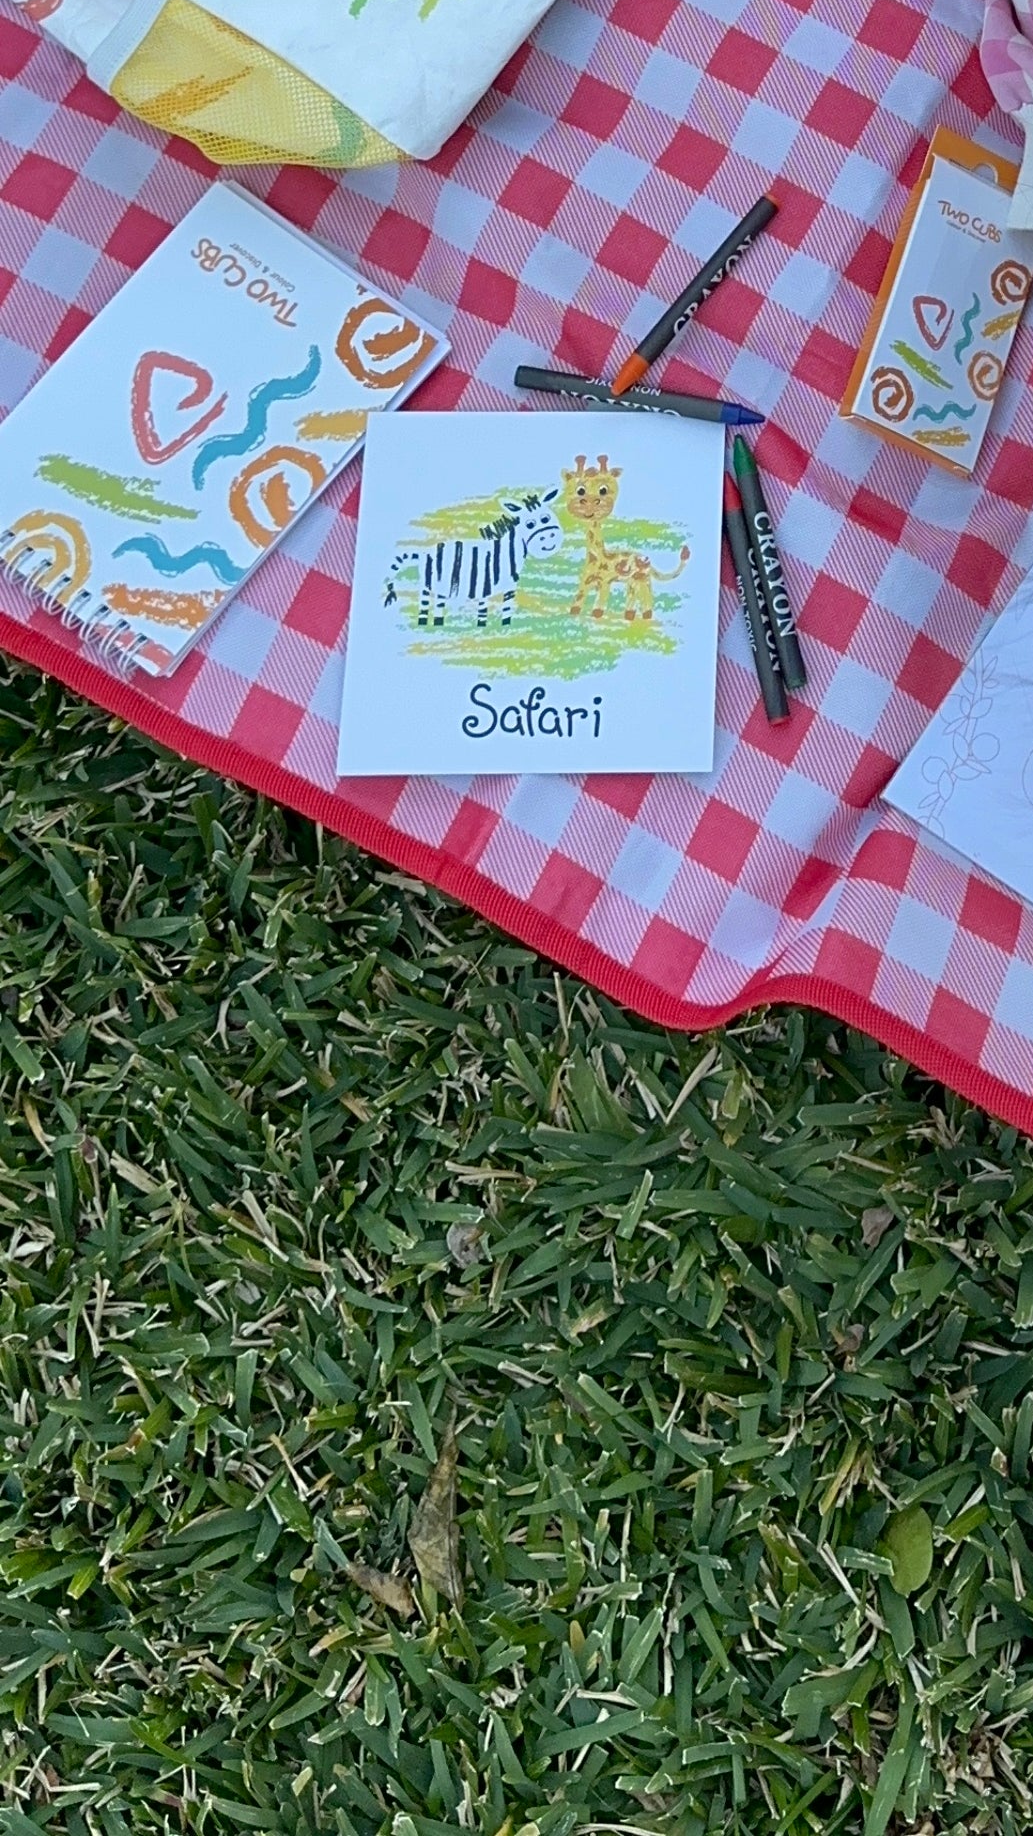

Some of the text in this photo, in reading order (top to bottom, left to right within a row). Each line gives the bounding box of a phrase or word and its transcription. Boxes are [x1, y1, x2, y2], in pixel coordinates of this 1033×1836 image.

[938, 200, 970, 226] TWO
[971, 217, 1003, 244] CUBS
[229, 243, 262, 269] Discover
[191, 238, 298, 327] TWO CUBS
[269, 271, 296, 293] Colour
[754, 511, 797, 638] CRAYON
[461, 683, 602, 739] Safari
